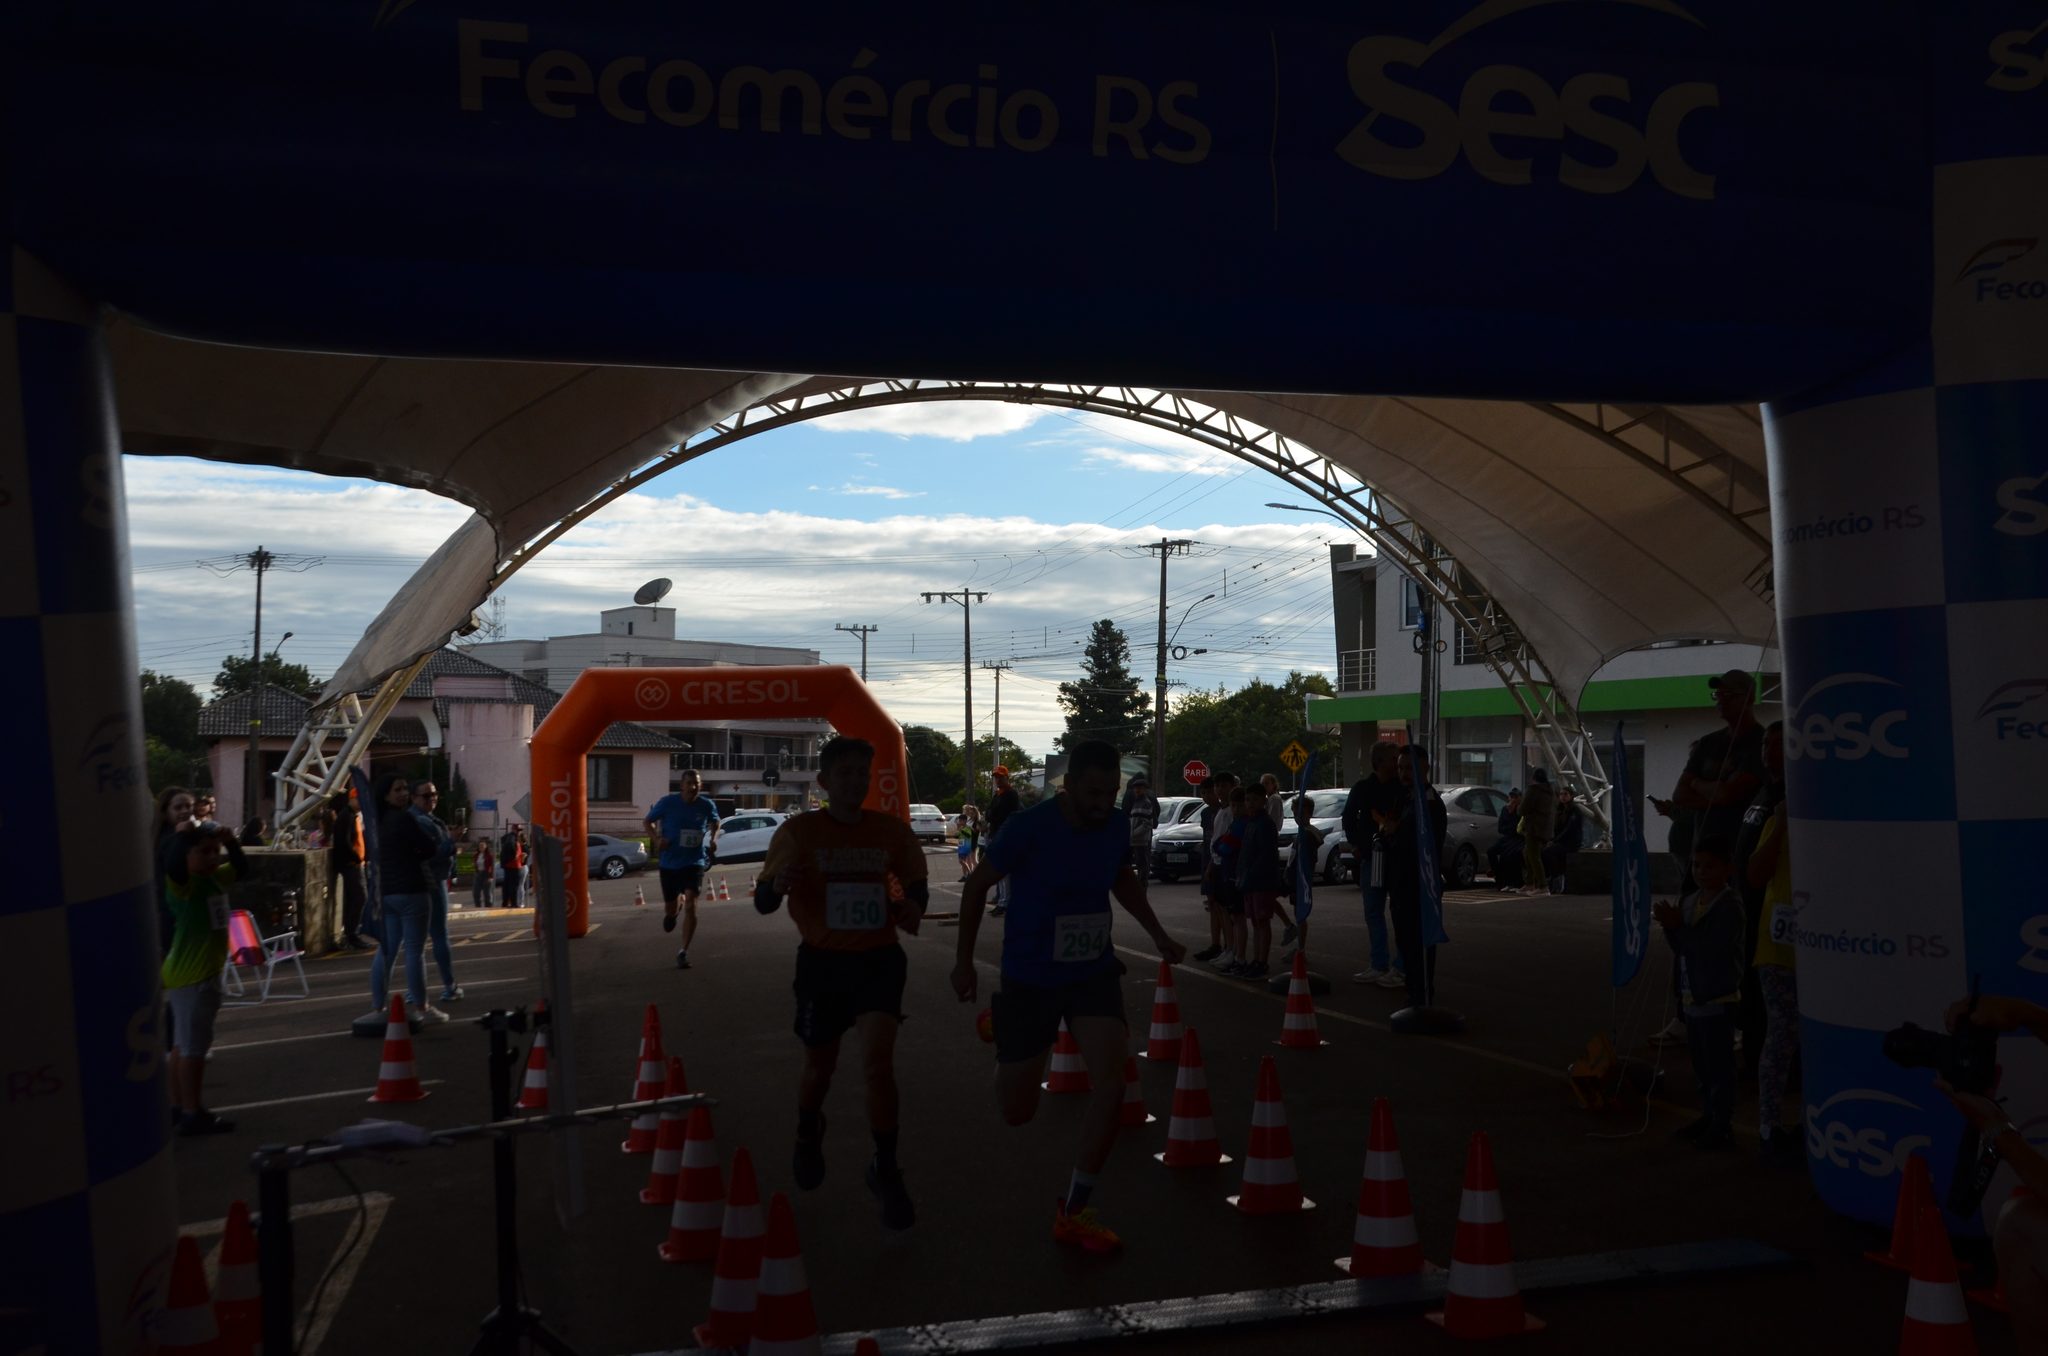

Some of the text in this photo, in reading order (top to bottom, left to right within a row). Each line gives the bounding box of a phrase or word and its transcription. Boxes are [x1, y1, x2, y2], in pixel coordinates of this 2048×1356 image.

[457, 17, 1212, 164] Fecomércio RS
[1333, 34, 1720, 200] Sesc
[1882, 505, 1925, 530] RS
[681, 679, 809, 705] CRESOL
[1185, 769, 1206, 777] PARE
[835, 900, 880, 925] 150
[1062, 929, 1104, 958] 294
[1906, 934, 1950, 959] RS
[7, 1064, 64, 1103] RS
